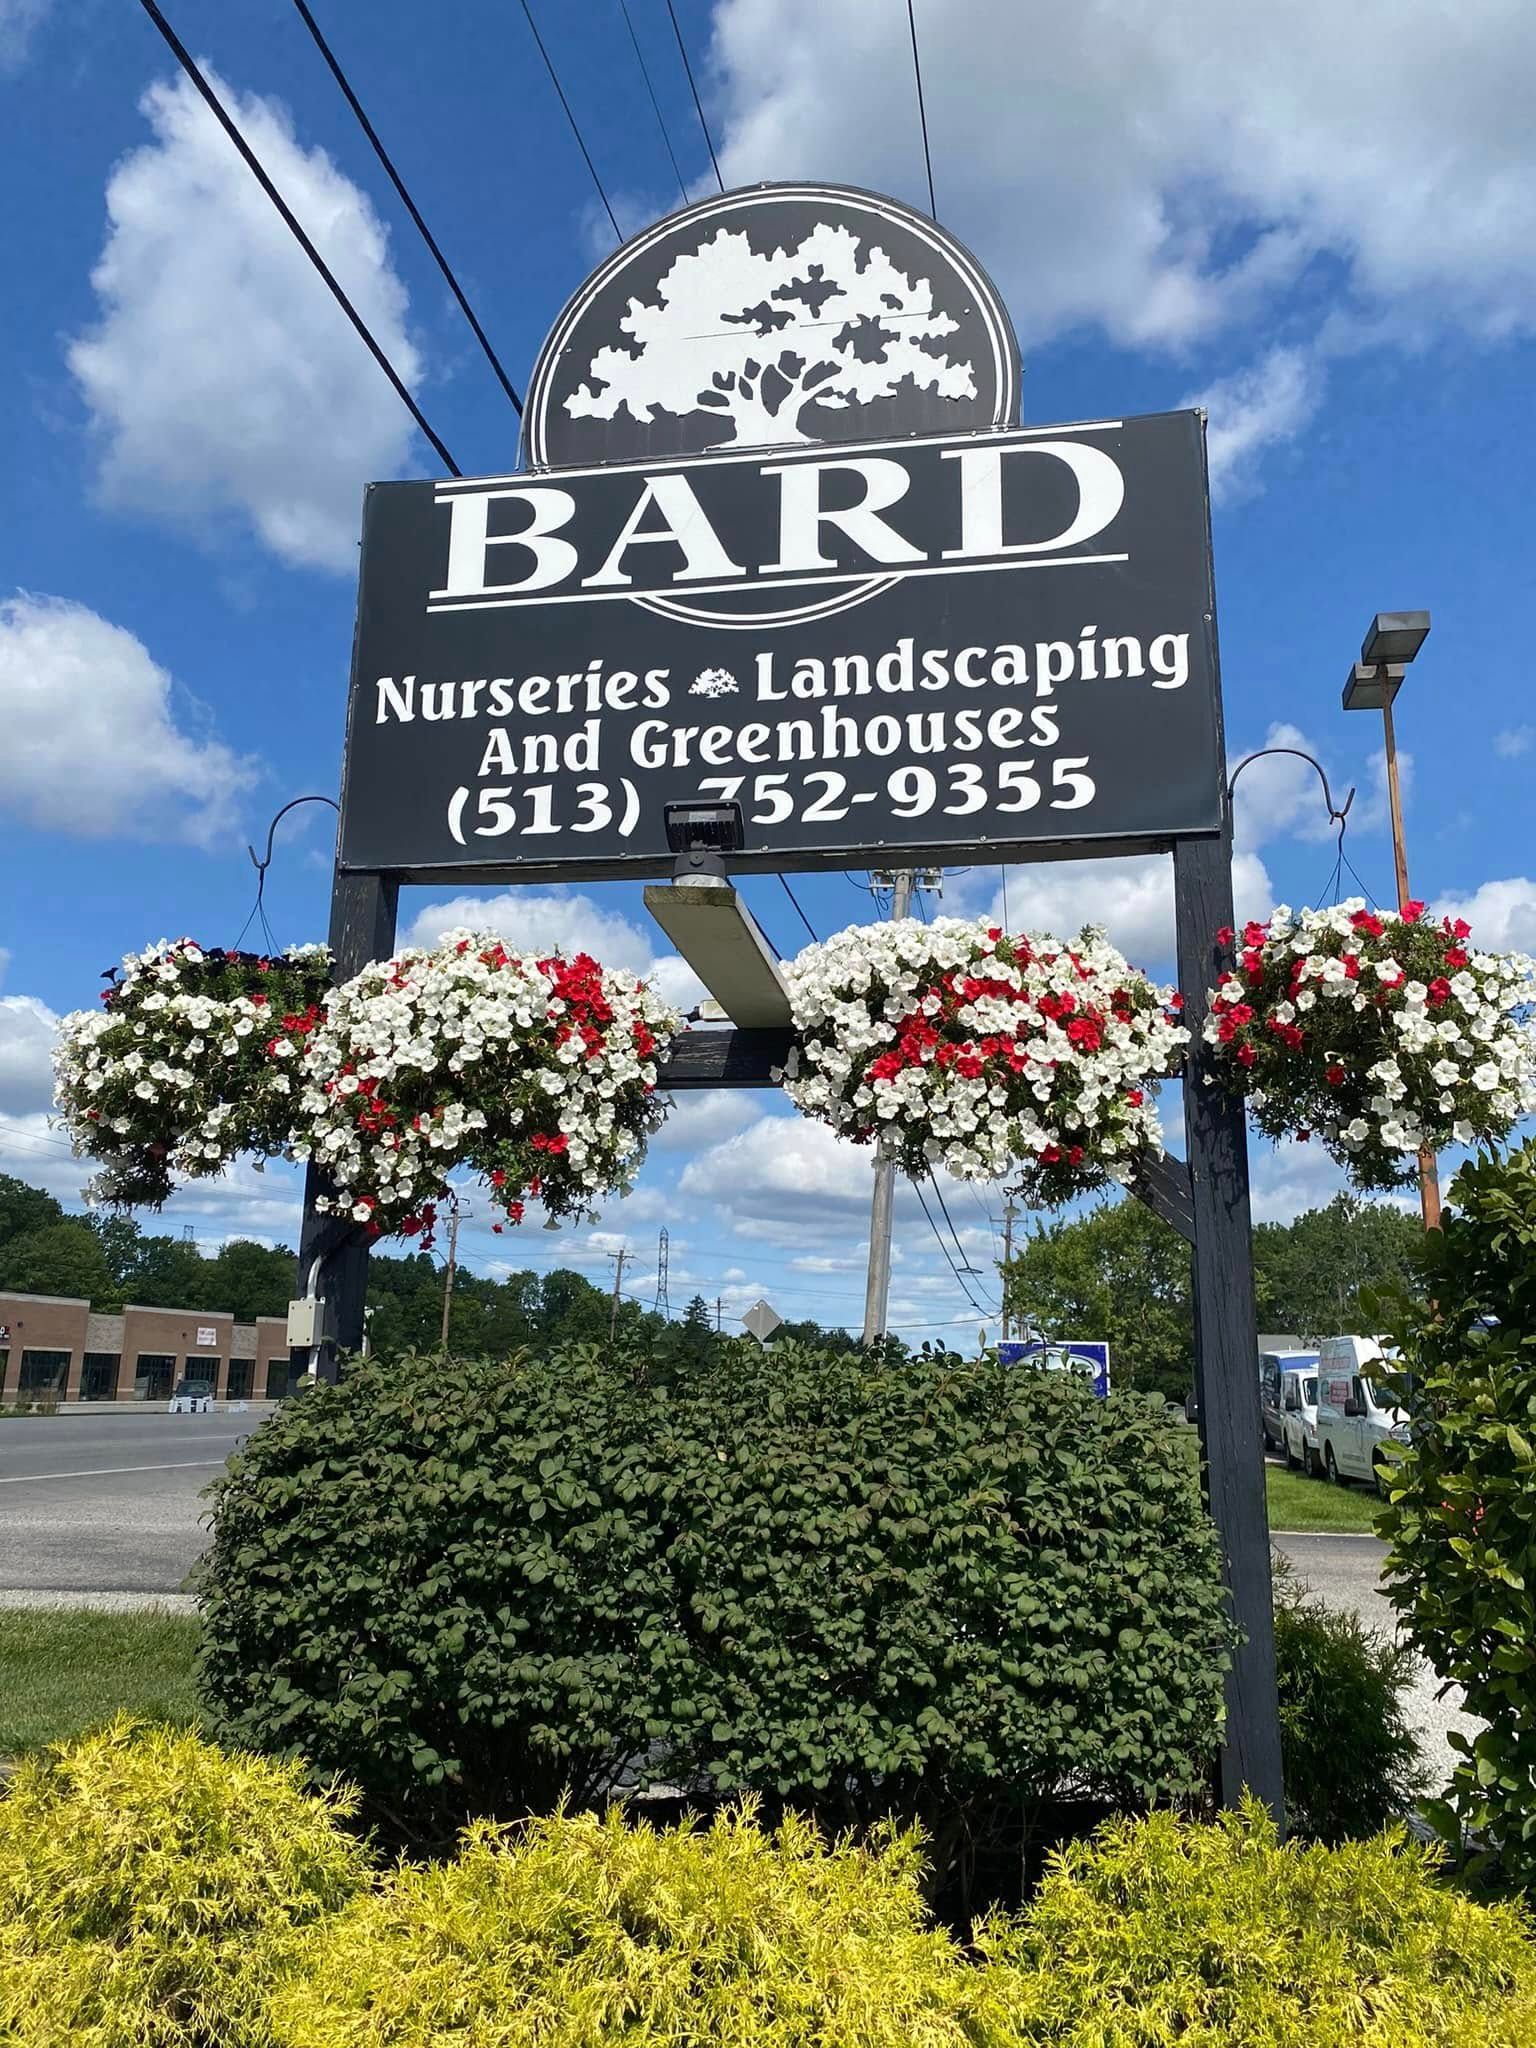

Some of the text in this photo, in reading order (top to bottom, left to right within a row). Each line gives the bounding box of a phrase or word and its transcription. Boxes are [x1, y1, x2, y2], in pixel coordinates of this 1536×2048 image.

[428, 440, 1126, 600] BARD
[375, 624, 1191, 725] Nurseries Landscaping
[477, 704, 1061, 778] And Greenhouses
[447, 777, 642, 847] (513)
